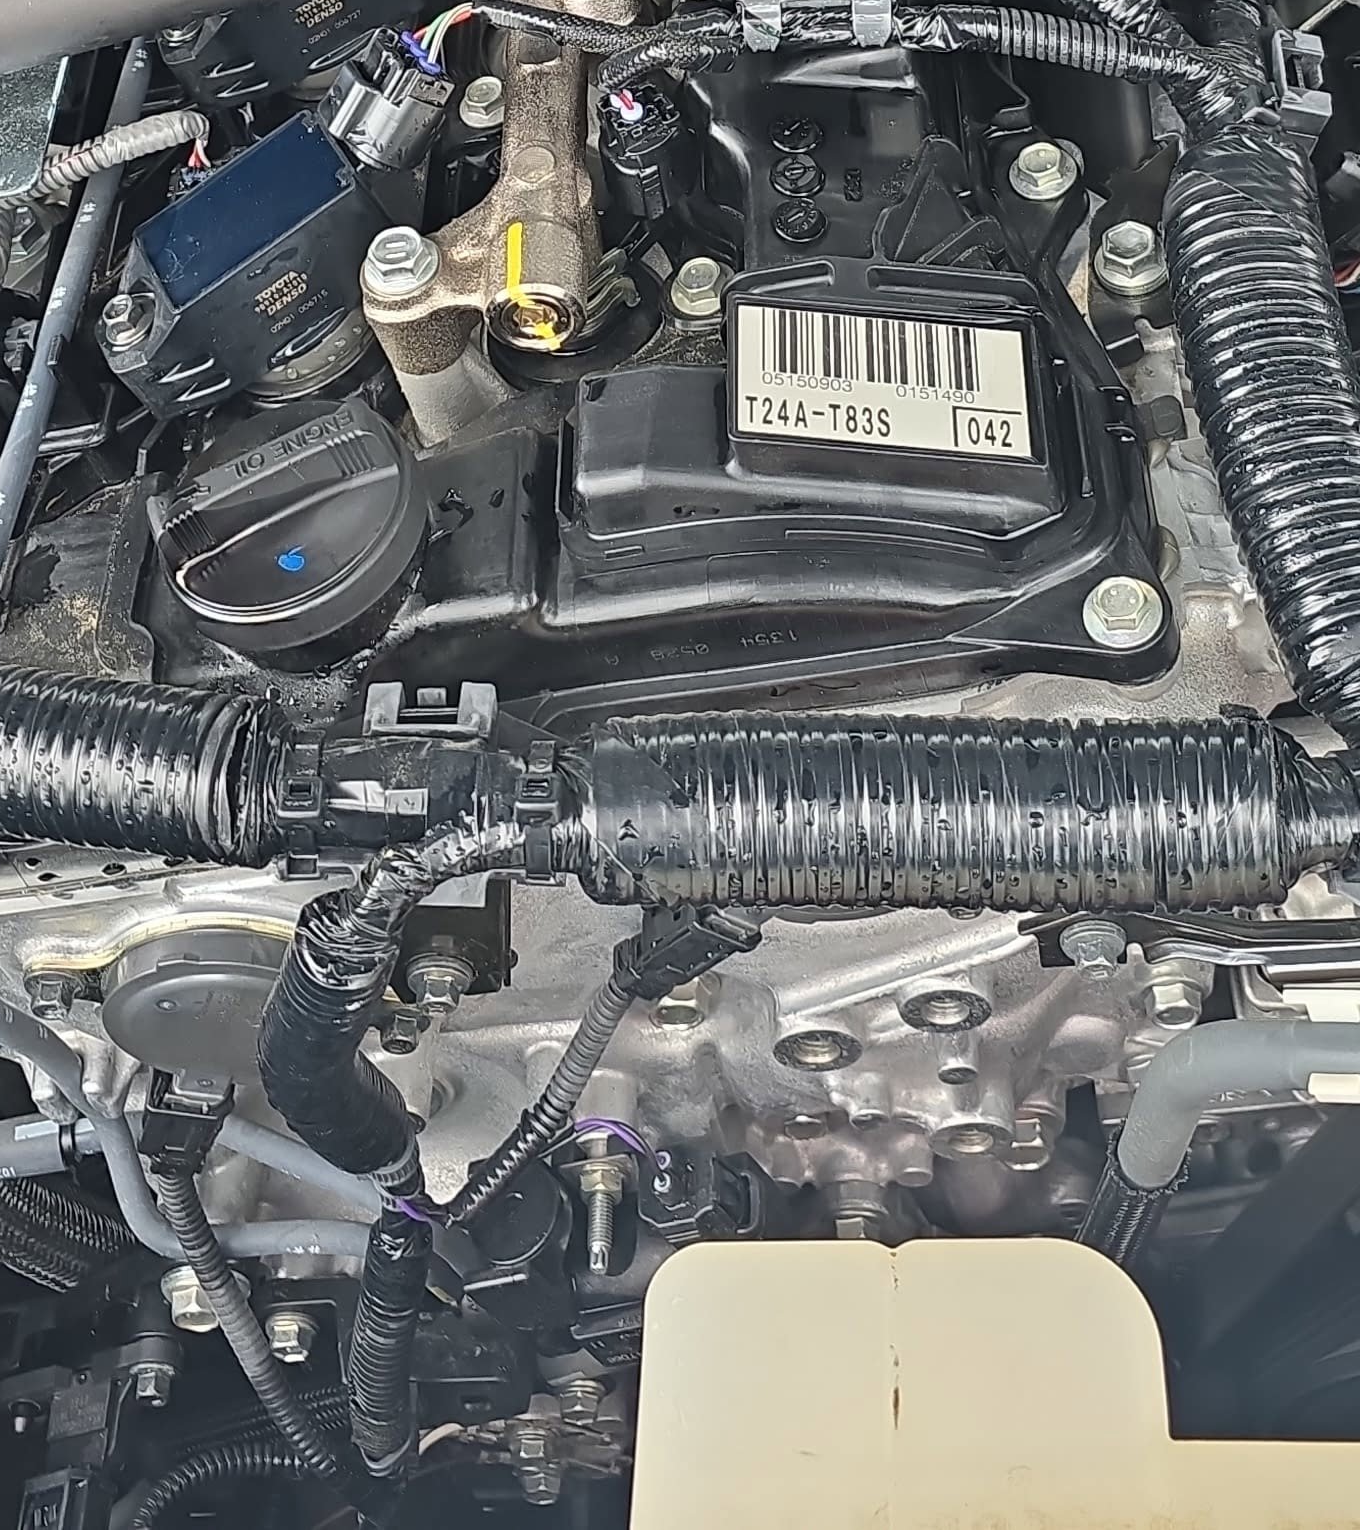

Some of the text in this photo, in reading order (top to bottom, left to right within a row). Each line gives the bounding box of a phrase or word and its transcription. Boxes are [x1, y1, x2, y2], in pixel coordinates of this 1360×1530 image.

[306, 1, 344, 28] DENSO
[254, 271, 299, 302] TOYOTA
[266, 282, 308, 316] DENSO
[761, 372, 976, 404] 05150903 0151490
[745, 395, 1013, 448] T24A-T83S 042
[225, 410, 354, 478] ENGINE OIL
